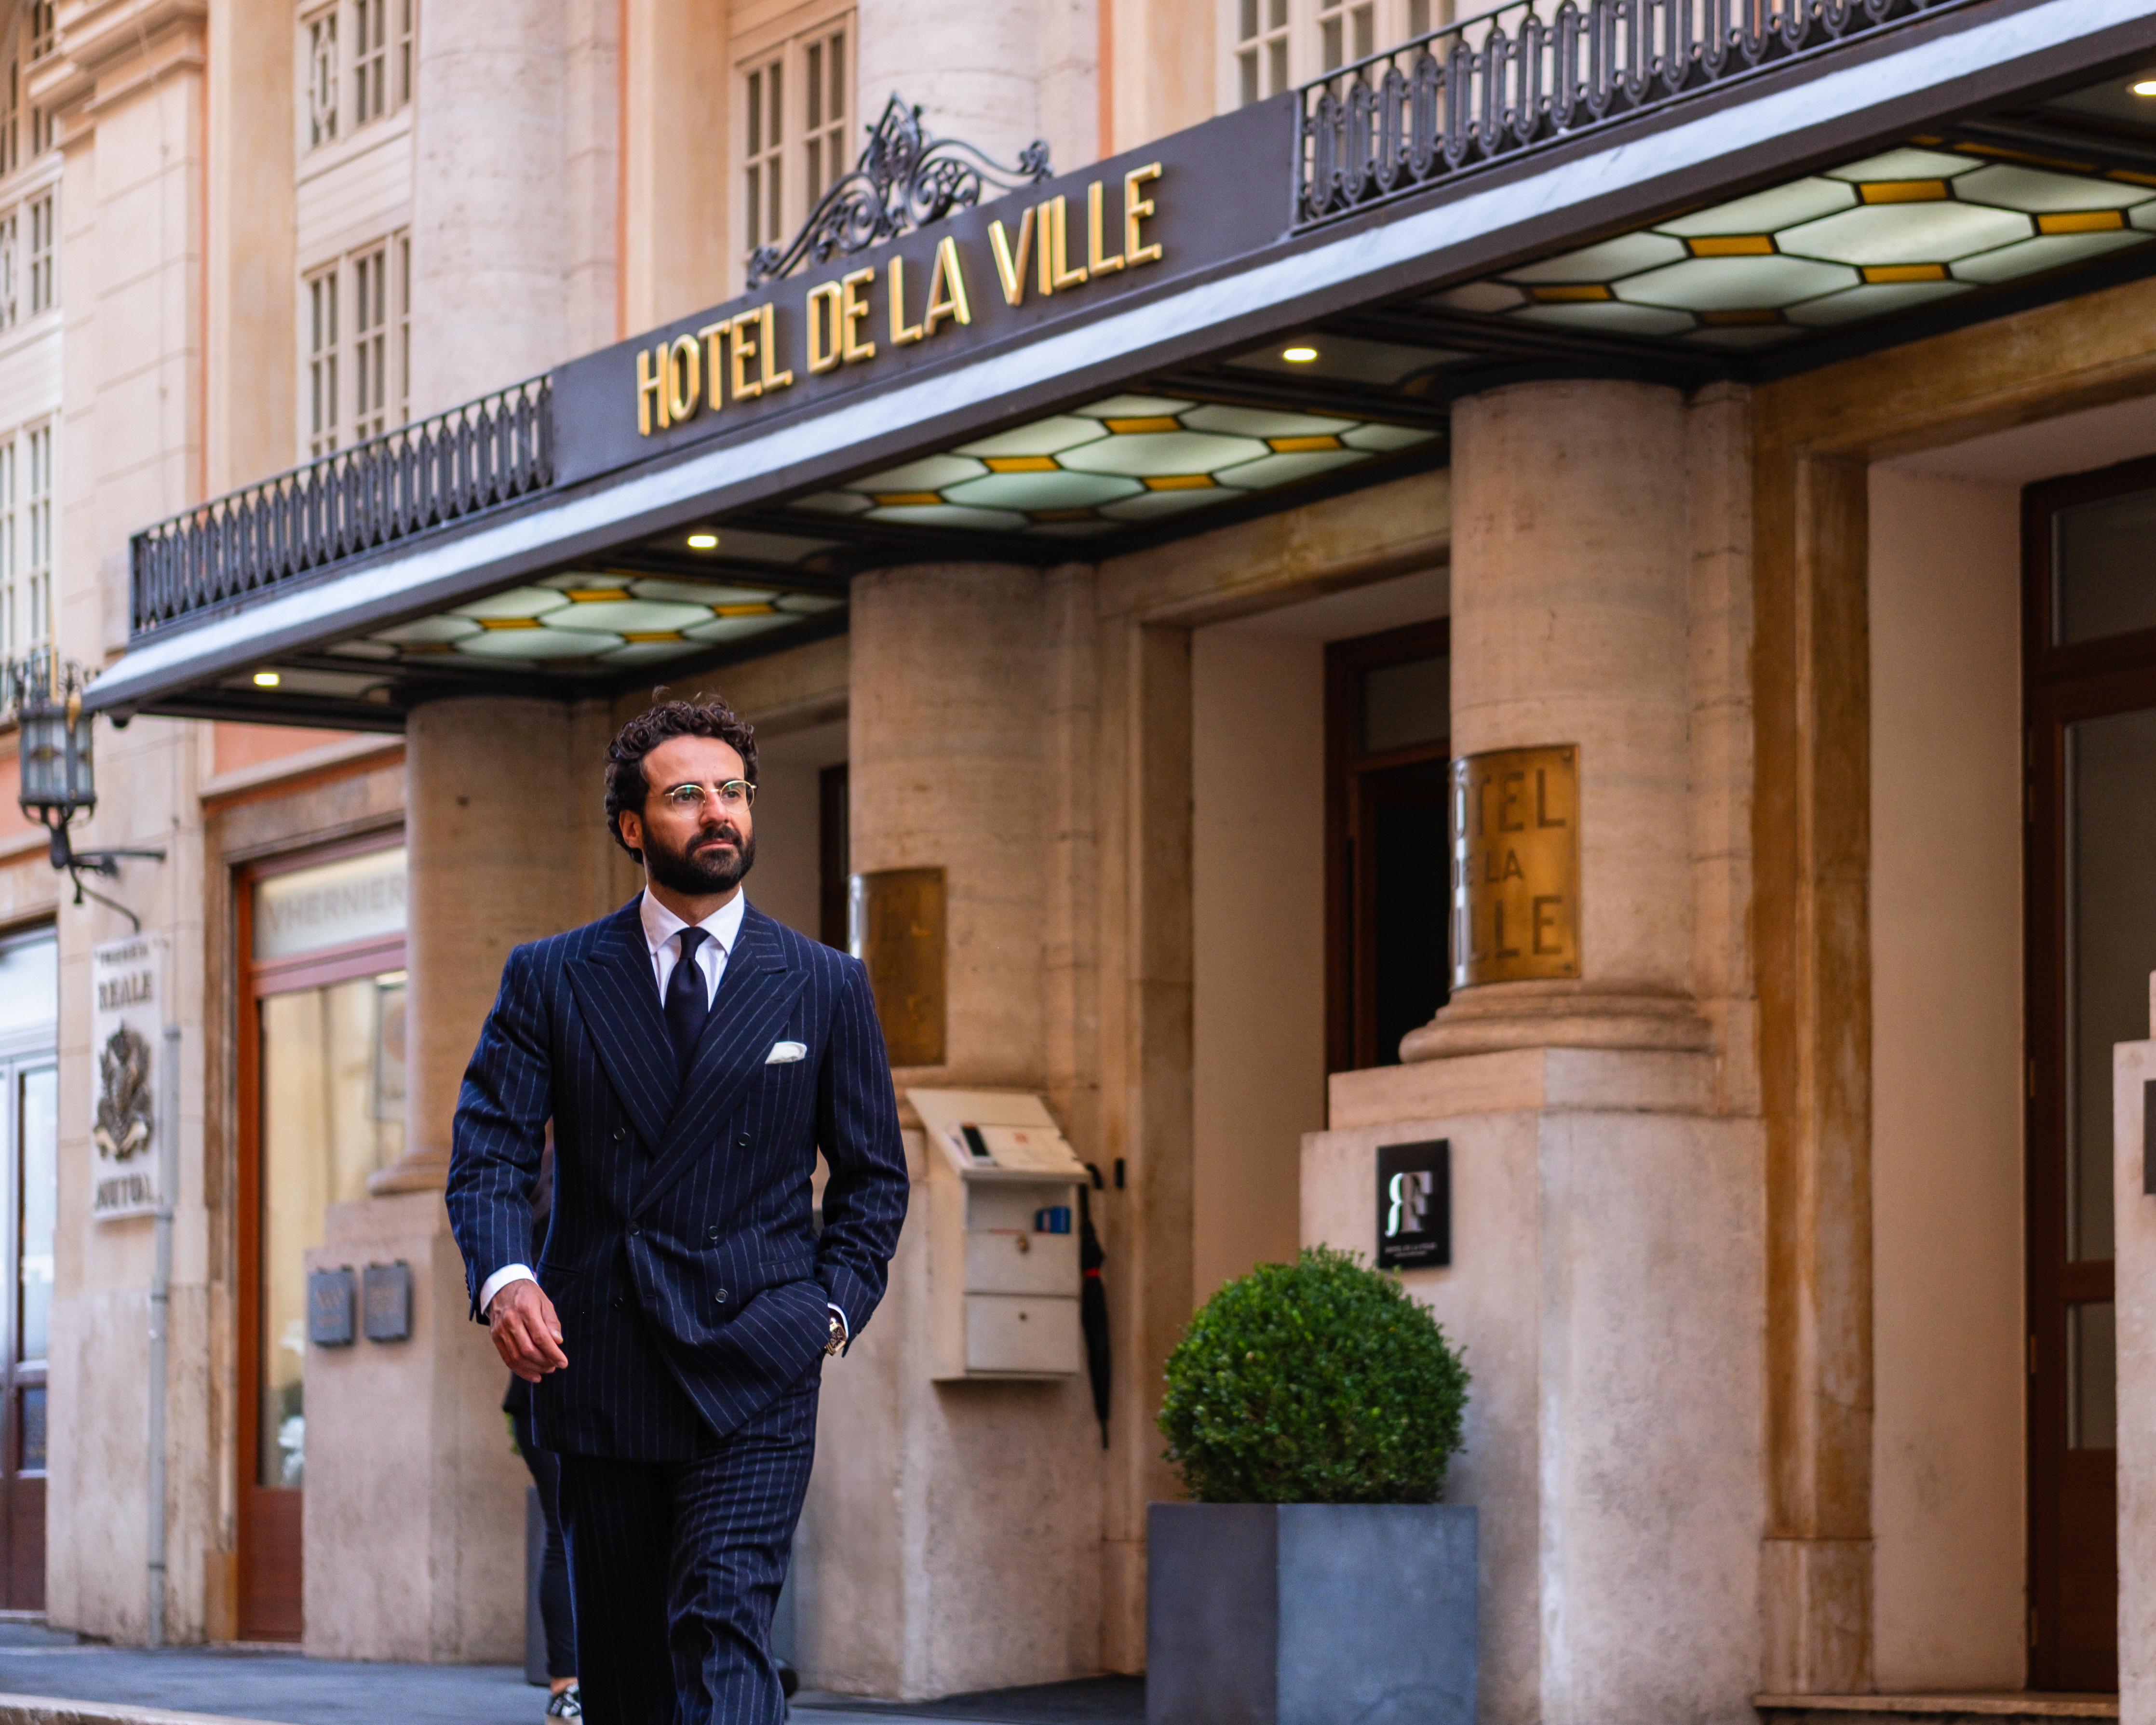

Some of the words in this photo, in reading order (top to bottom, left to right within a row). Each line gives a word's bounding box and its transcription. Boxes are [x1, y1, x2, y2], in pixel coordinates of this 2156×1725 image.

[636, 303, 793, 436] HOTEL
[807, 267, 876, 375] DE
[888, 235, 970, 346] LA
[988, 162, 1162, 307] VILLE
[1485, 848, 1523, 883] LA
[98, 970, 153, 1011] REALE
